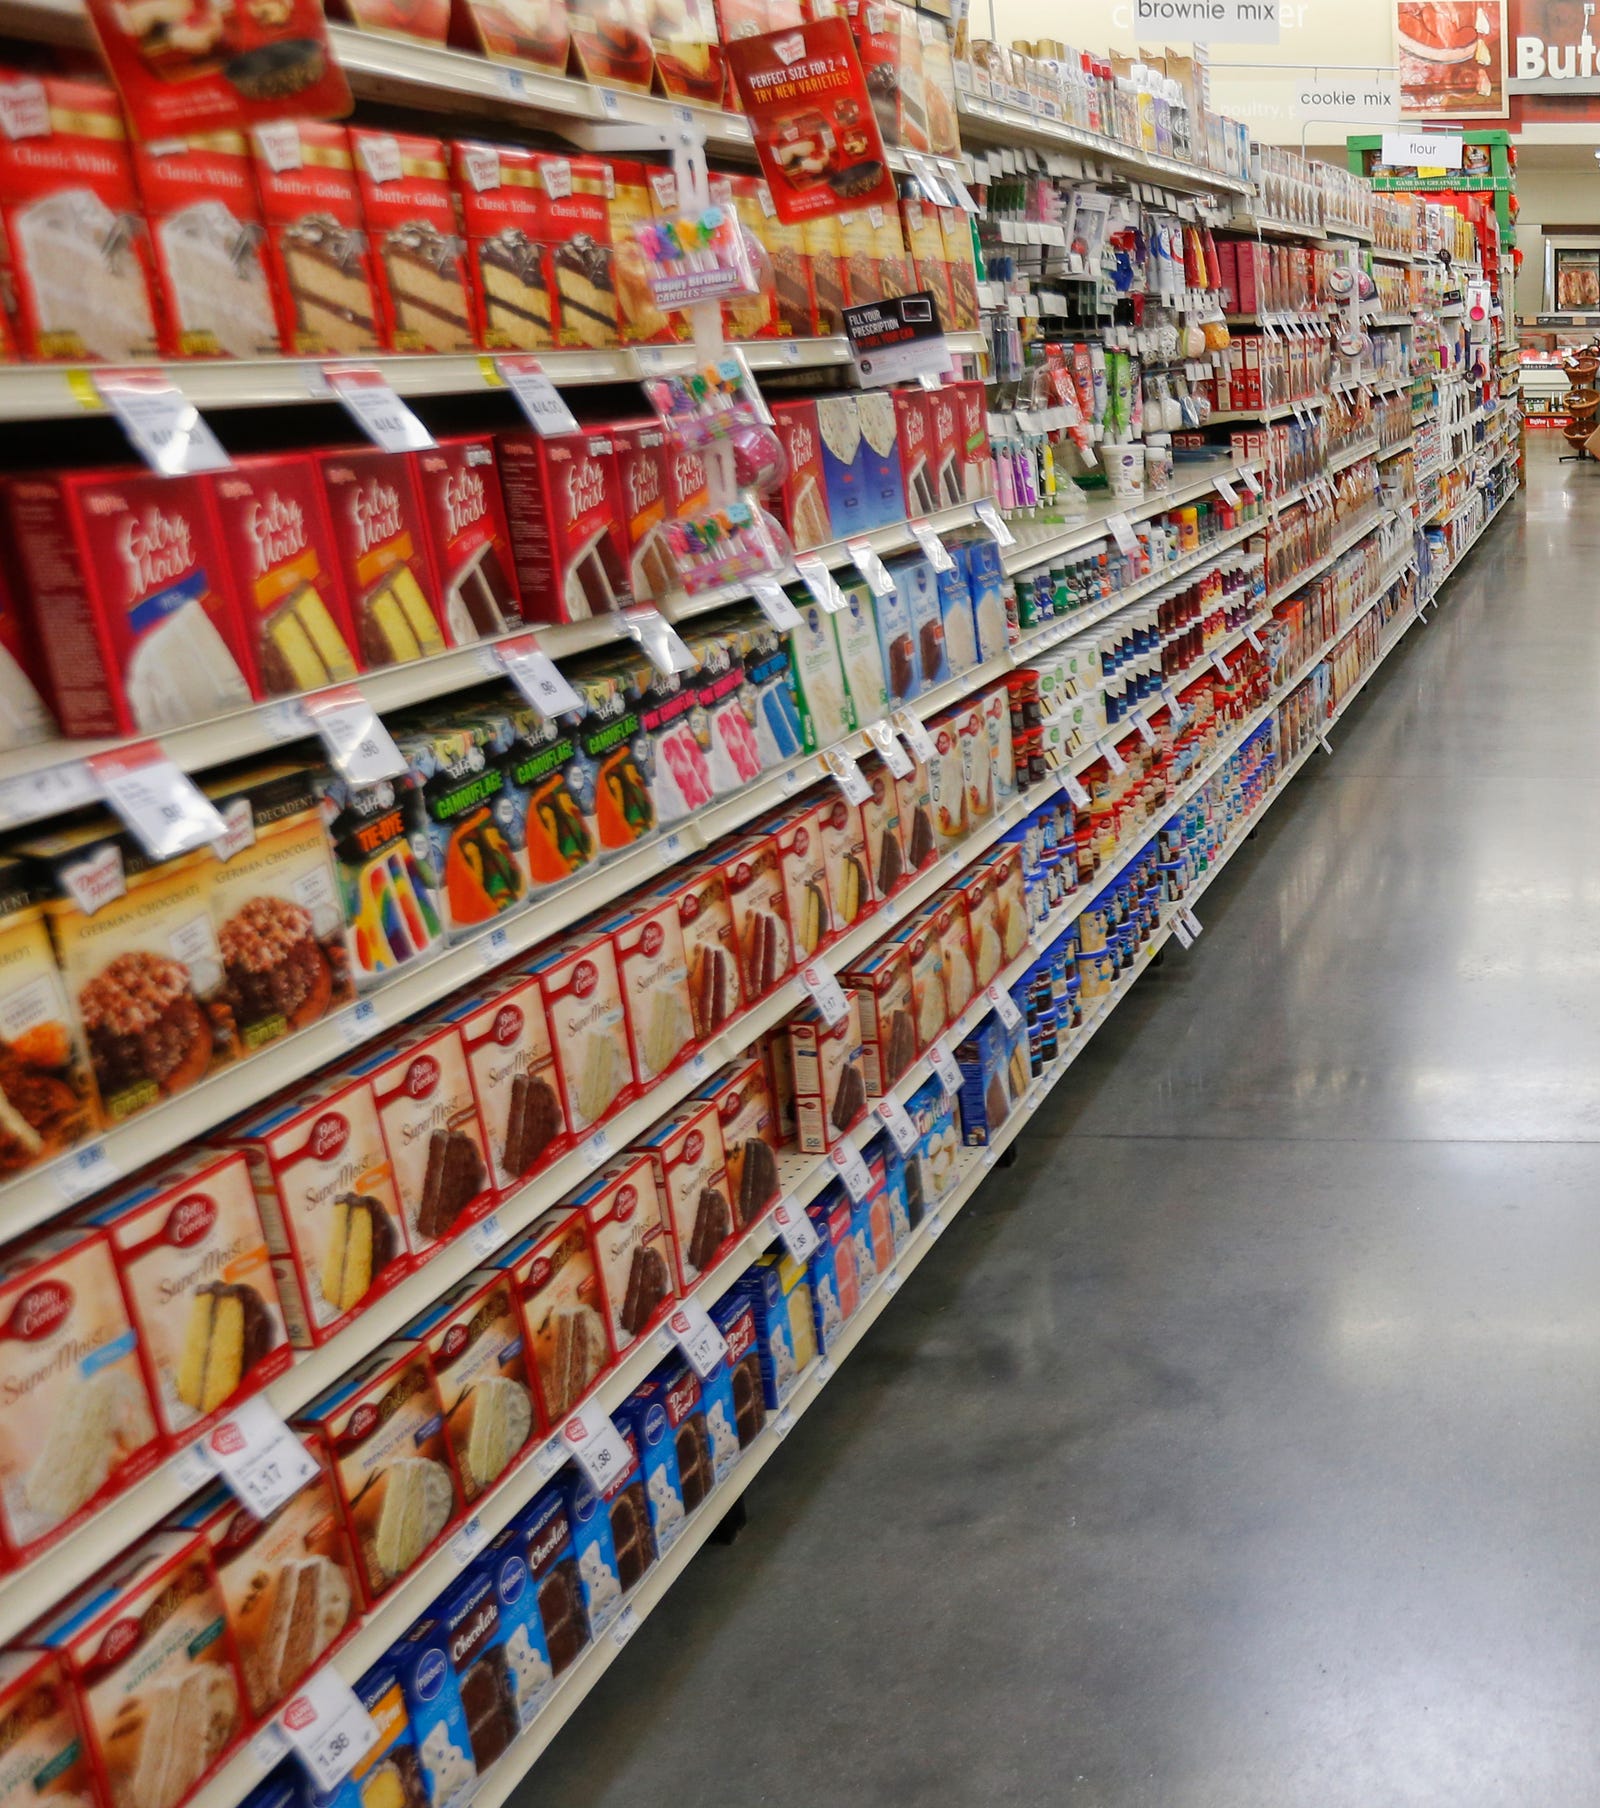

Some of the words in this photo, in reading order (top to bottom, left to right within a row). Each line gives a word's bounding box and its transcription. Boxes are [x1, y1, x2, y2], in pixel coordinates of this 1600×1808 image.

[1138, 0, 1225, 20] brownie
[1236, 0, 1274, 20] mix
[750, 70, 788, 89] PERFECT
[790, 65, 809, 82] SIZE
[810, 61, 828, 76] FOR
[754, 88, 773, 104] TRY
[775, 84, 797, 100] NEW
[1300, 91, 1356, 106] cookie
[1363, 91, 1392, 106] mix
[1409, 142, 1437, 156] flour
[259, 795, 314, 824] DECADENT
[531, 1519, 569, 1570] Chocolate
[453, 1604, 499, 1662] Chocolate
[317, 1732, 350, 1767] 1.38
